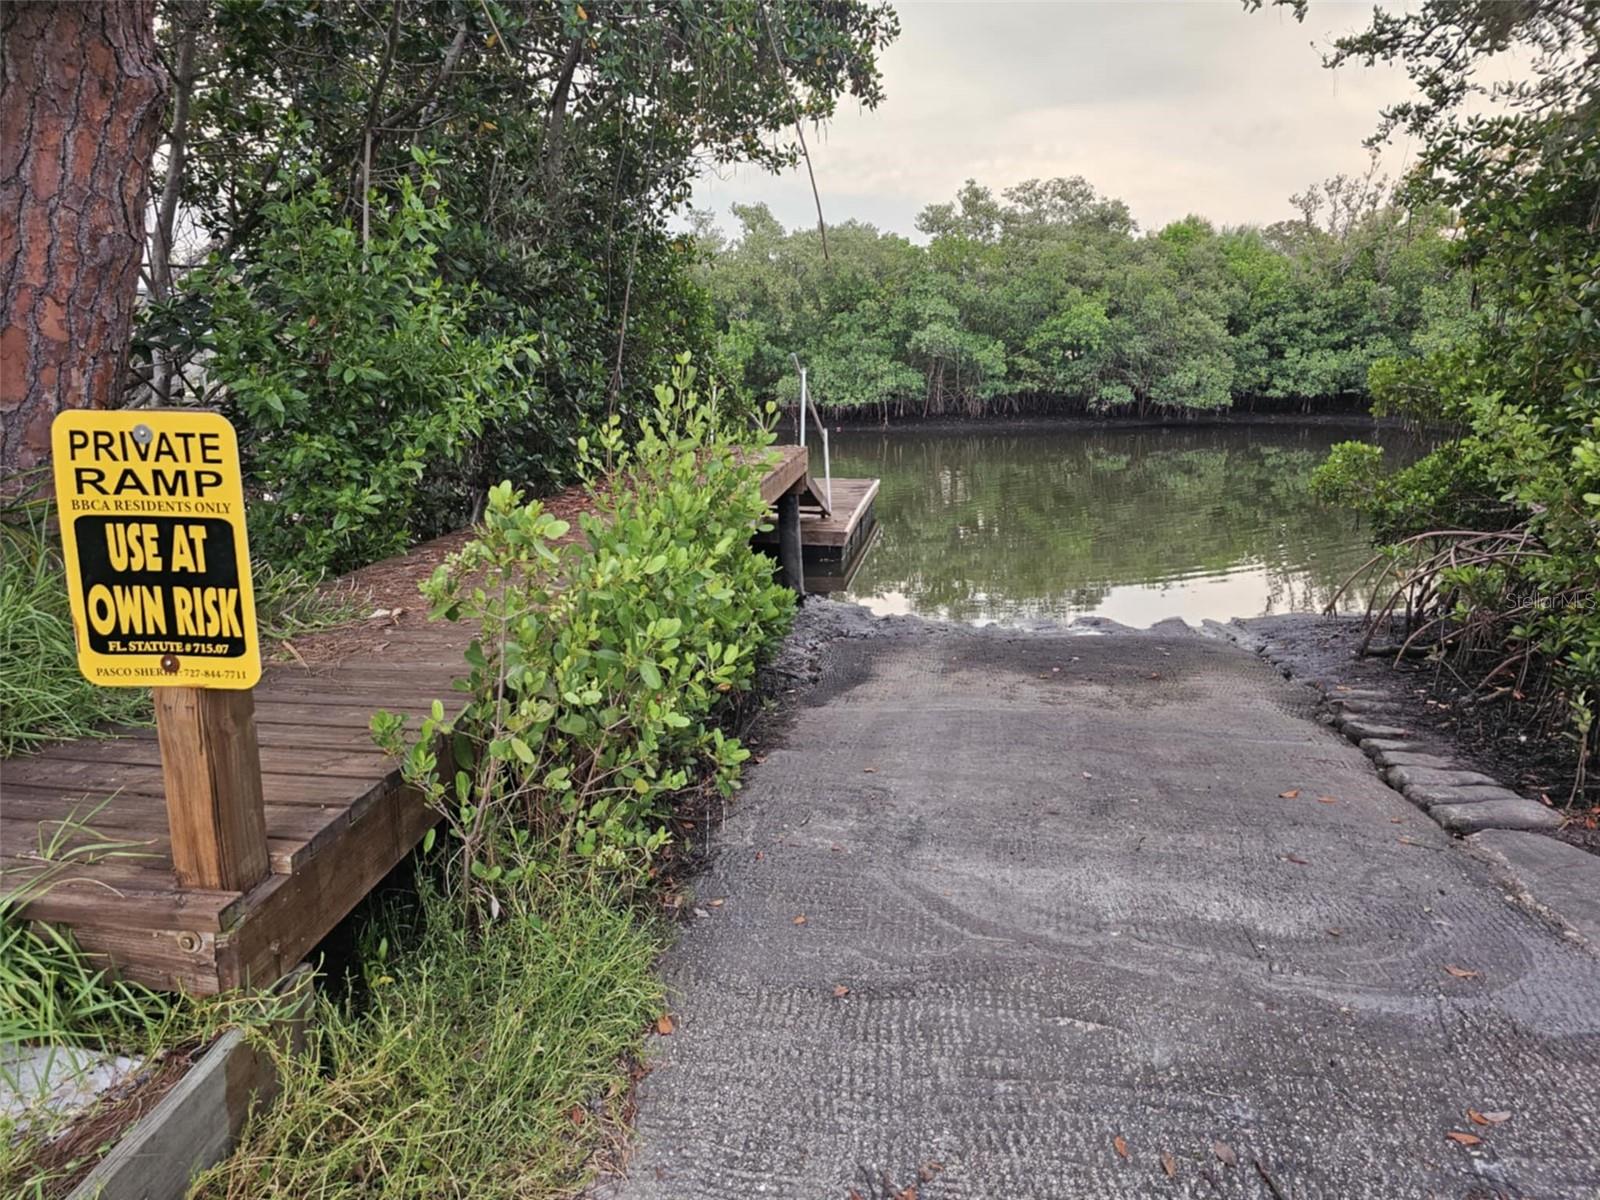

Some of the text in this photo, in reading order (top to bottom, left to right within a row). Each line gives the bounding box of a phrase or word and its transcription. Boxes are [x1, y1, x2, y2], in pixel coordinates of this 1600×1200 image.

[68, 430, 223, 464] PRIVATE
[74, 468, 223, 497] RAMP
[71, 499, 231, 514] BBCA RESIDENTS ONLY
[105, 523, 207, 573] USE AT
[88, 583, 243, 638] OWN RISK
[128, 640, 184, 652] STATUTE
[96, 667, 132, 676] PASCO
